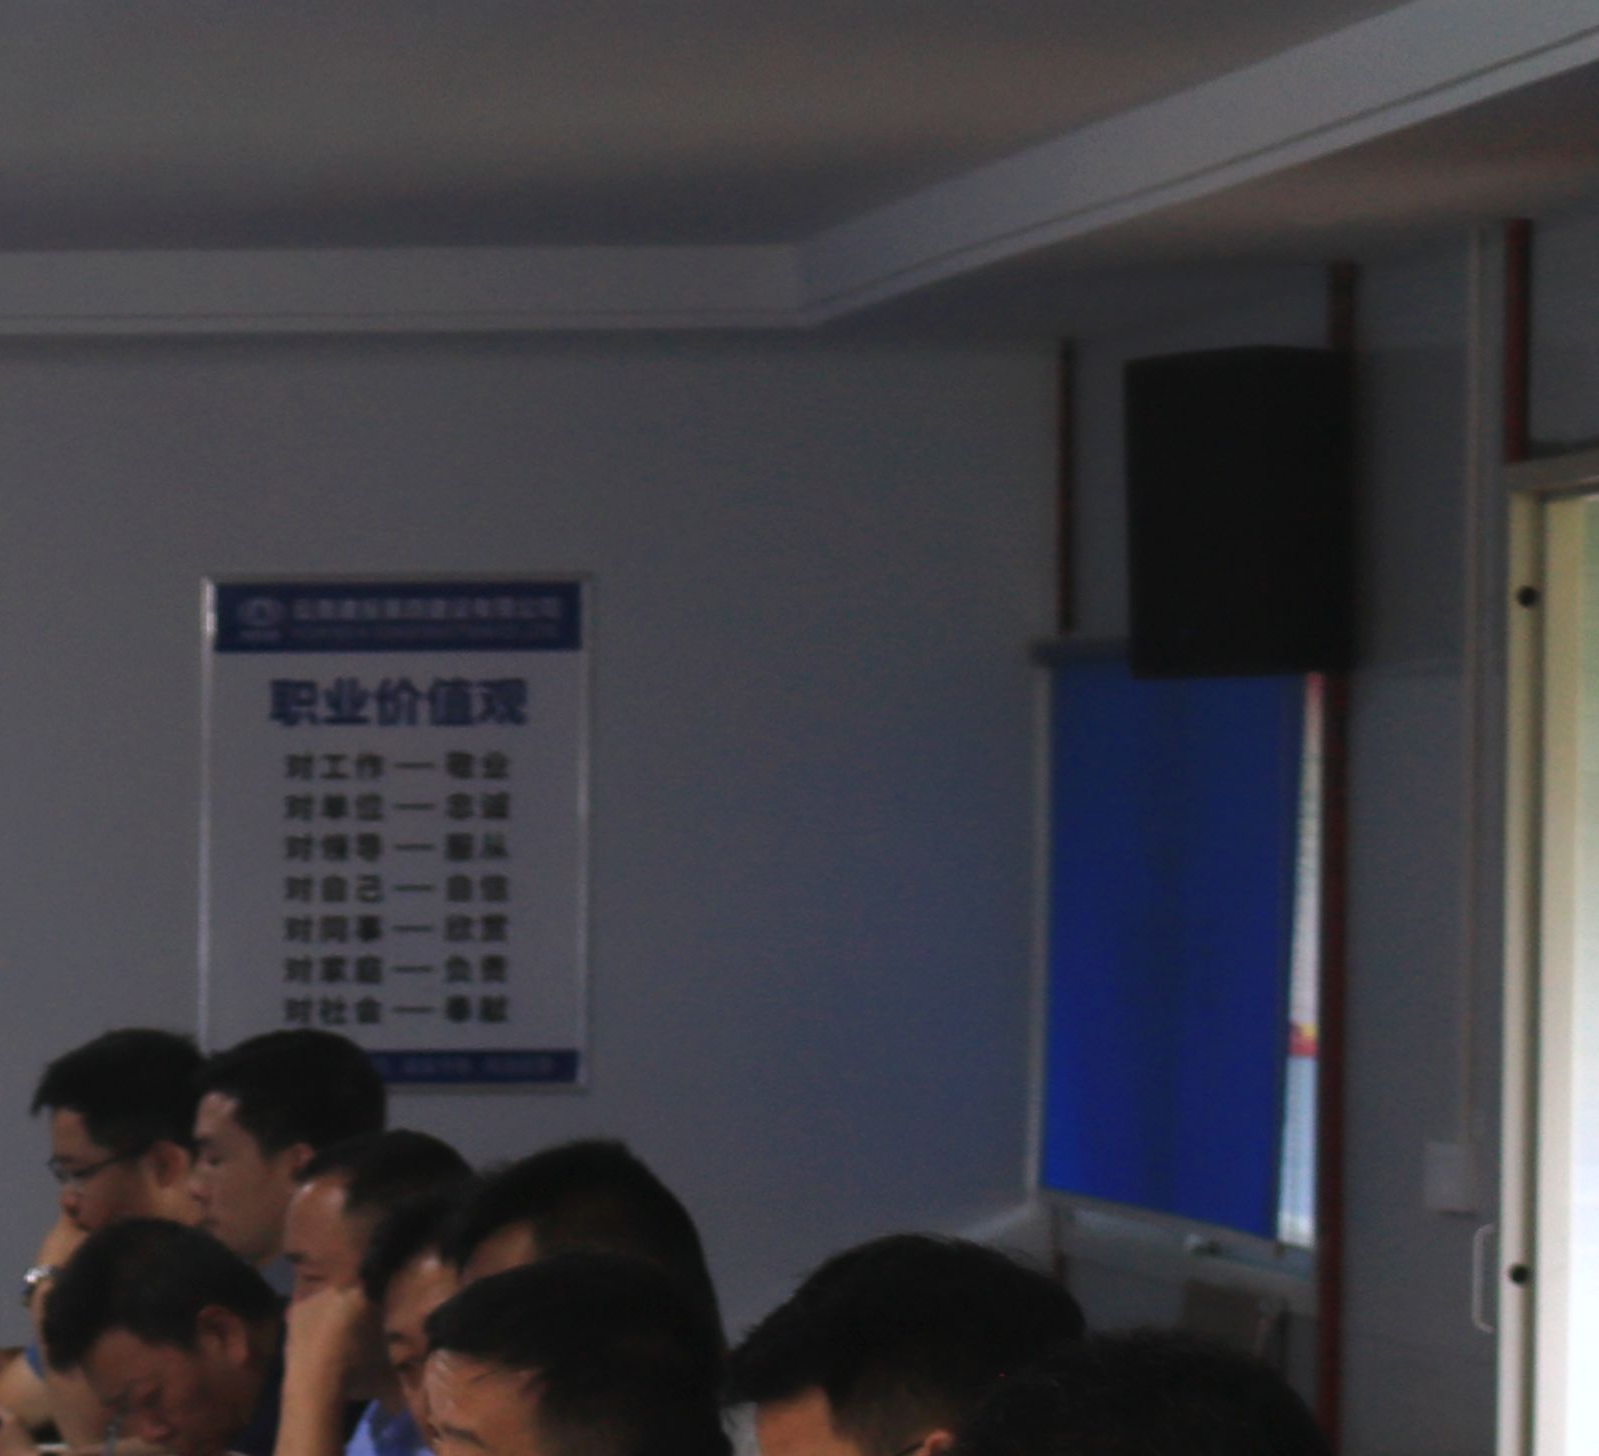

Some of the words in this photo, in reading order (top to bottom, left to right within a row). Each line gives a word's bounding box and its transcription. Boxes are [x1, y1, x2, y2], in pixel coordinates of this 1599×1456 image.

[269, 678, 528, 727] 职业价值观
